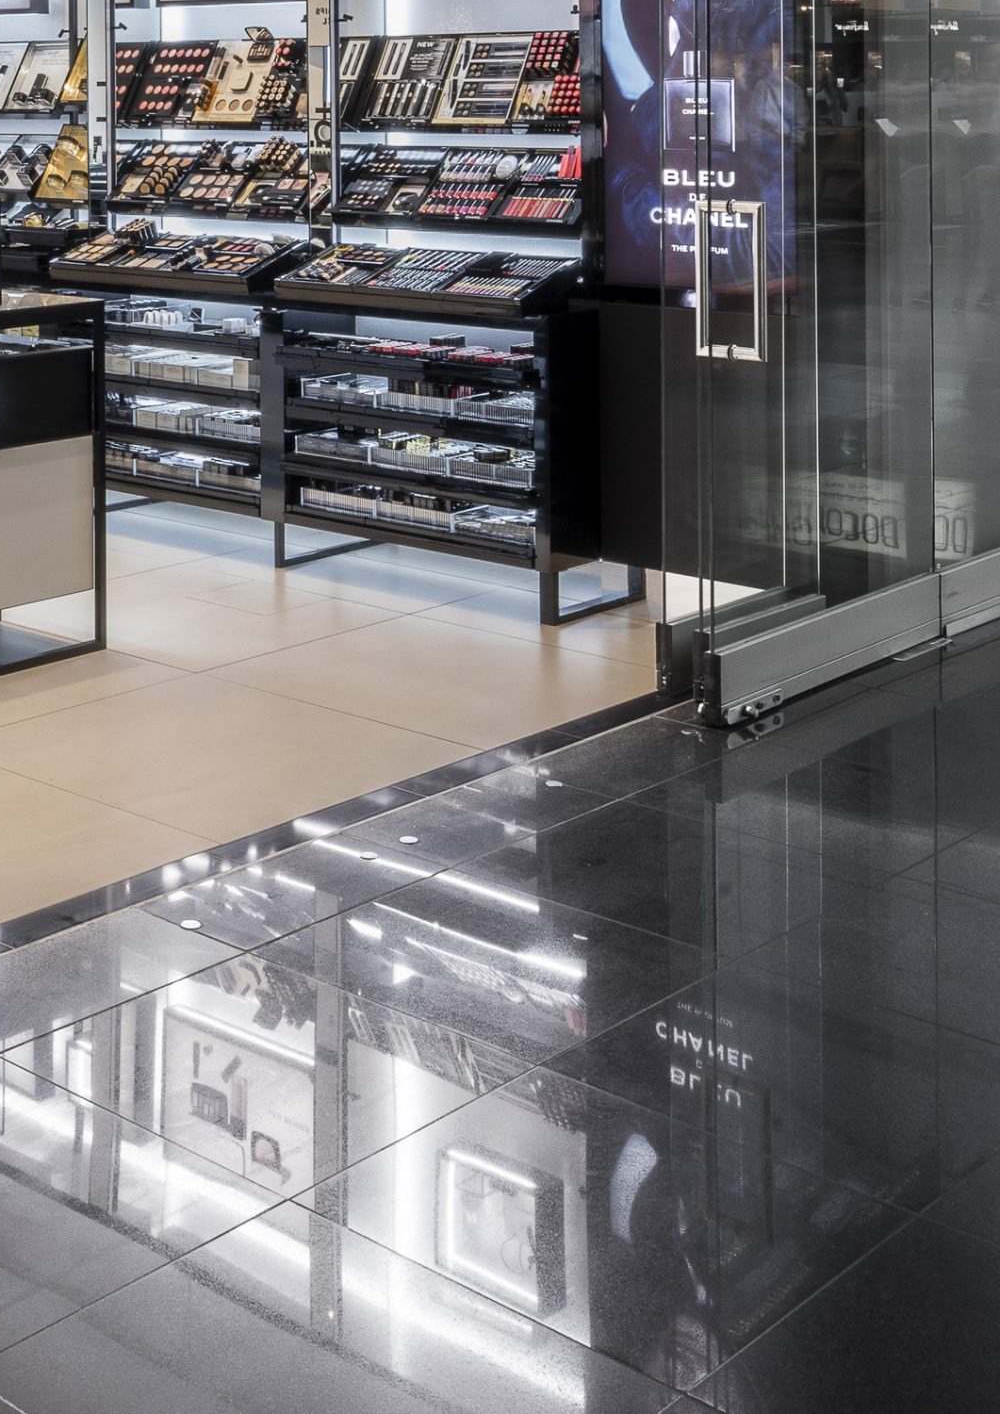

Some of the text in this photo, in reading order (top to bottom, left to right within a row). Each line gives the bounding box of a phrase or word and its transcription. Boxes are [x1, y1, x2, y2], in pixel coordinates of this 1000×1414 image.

[663, 169, 735, 187] BLEU
[689, 193, 706, 202] DE
[671, 245, 688, 253] THE
